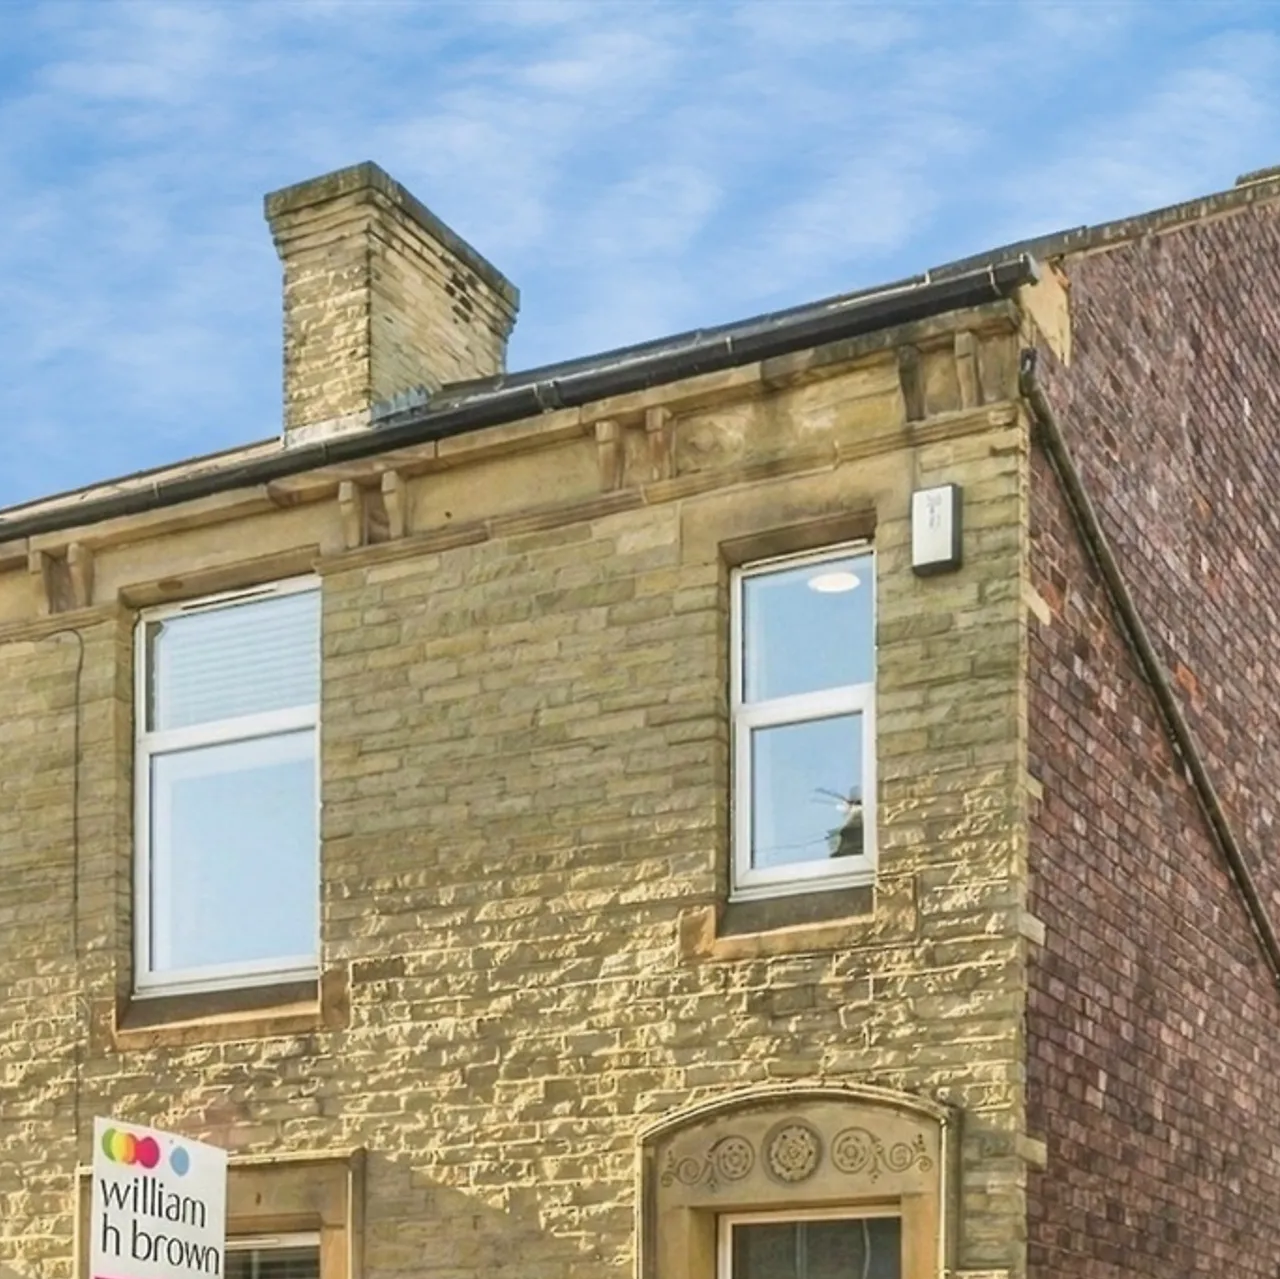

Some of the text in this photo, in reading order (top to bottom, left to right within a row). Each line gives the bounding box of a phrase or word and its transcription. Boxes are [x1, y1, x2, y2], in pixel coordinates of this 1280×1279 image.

[100, 1176, 206, 1228] william
[102, 1213, 220, 1275] h brown
